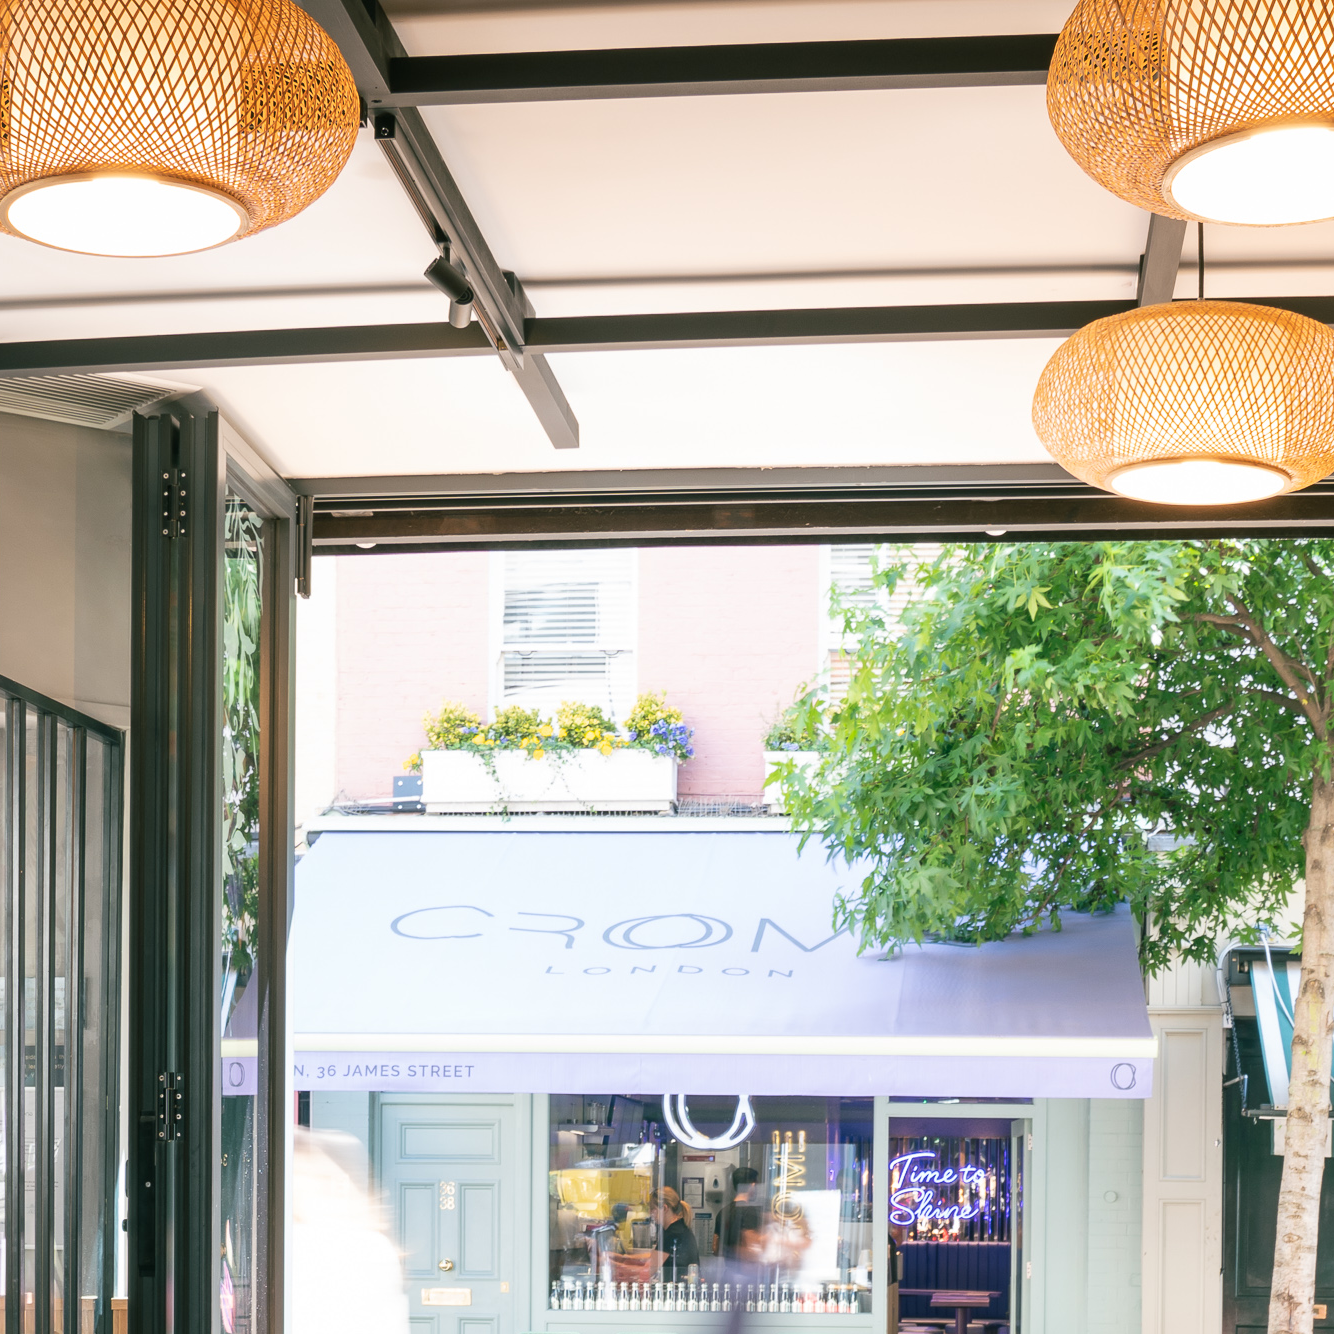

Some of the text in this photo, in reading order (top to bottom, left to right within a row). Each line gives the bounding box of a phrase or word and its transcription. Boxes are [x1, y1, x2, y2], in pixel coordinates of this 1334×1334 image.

[389, 905, 860, 953] CROM
[544, 964, 795, 978] LONDON
[317, 1064, 337, 1079] 36
[343, 1064, 401, 1077] JAMES
[407, 1064, 476, 1078] STREET
[889, 1151, 986, 1188] Time to
[439, 1181, 455, 1195] 36
[439, 1196, 455, 1210] 38
[889, 1187, 980, 1226] Shine
